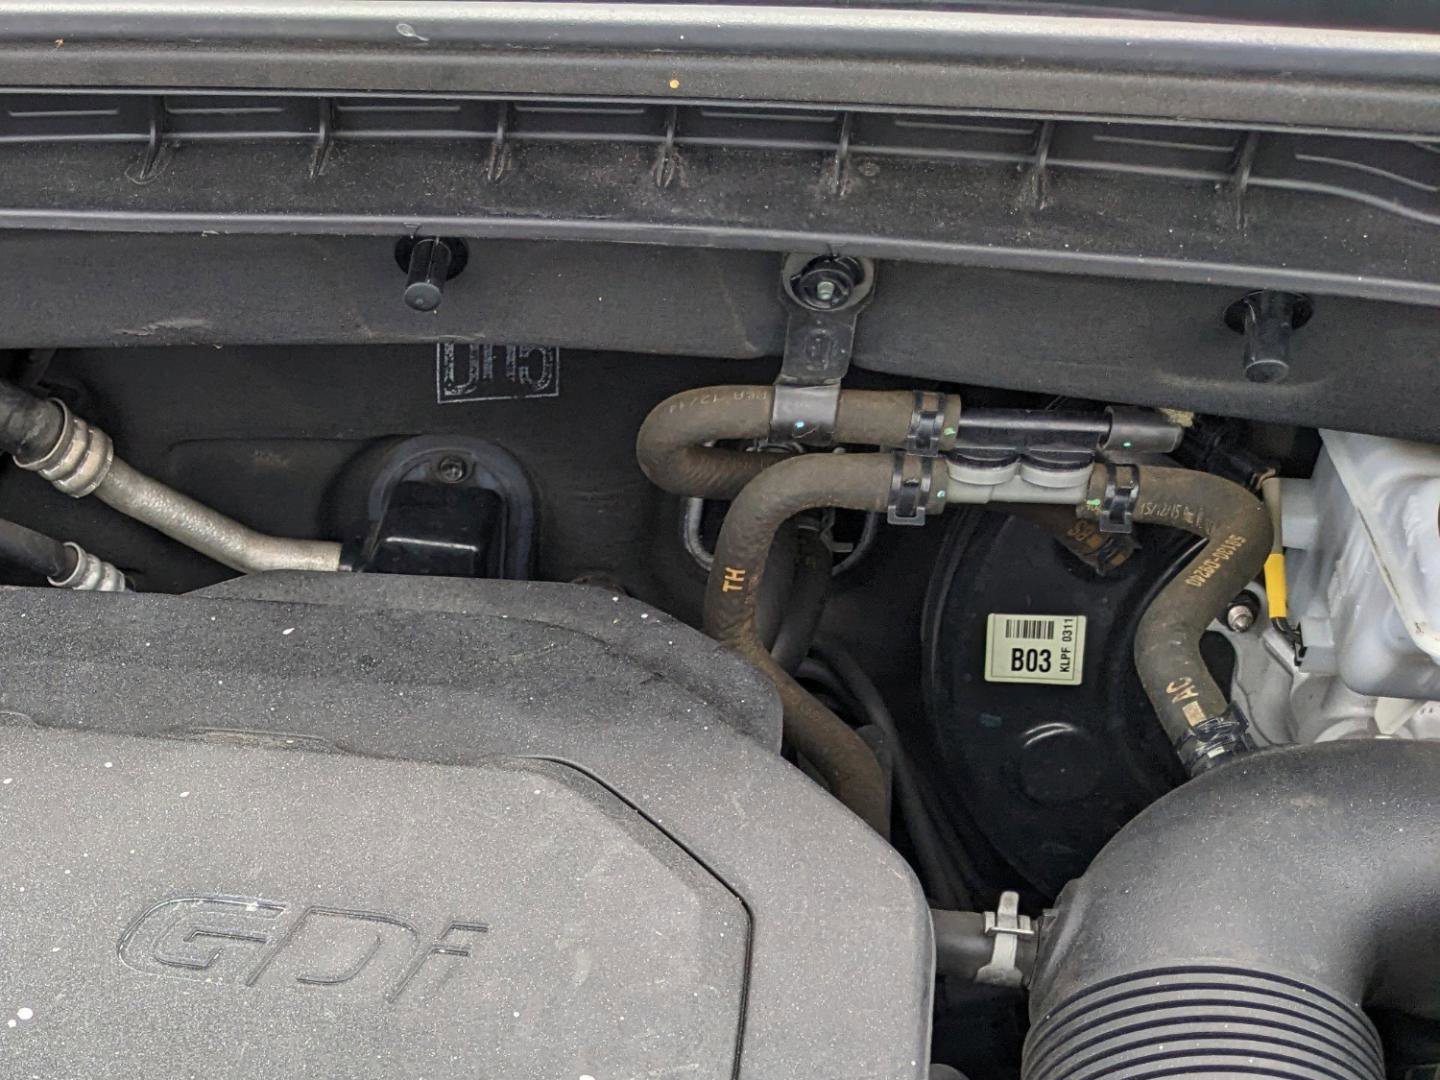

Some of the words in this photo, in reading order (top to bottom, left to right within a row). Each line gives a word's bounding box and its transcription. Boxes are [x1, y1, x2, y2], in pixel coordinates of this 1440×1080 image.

[723, 567, 746, 592] TH
[1011, 647, 1052, 673] B03
[1059, 646, 1071, 672] KLPF
[1166, 676, 1199, 703] AC
